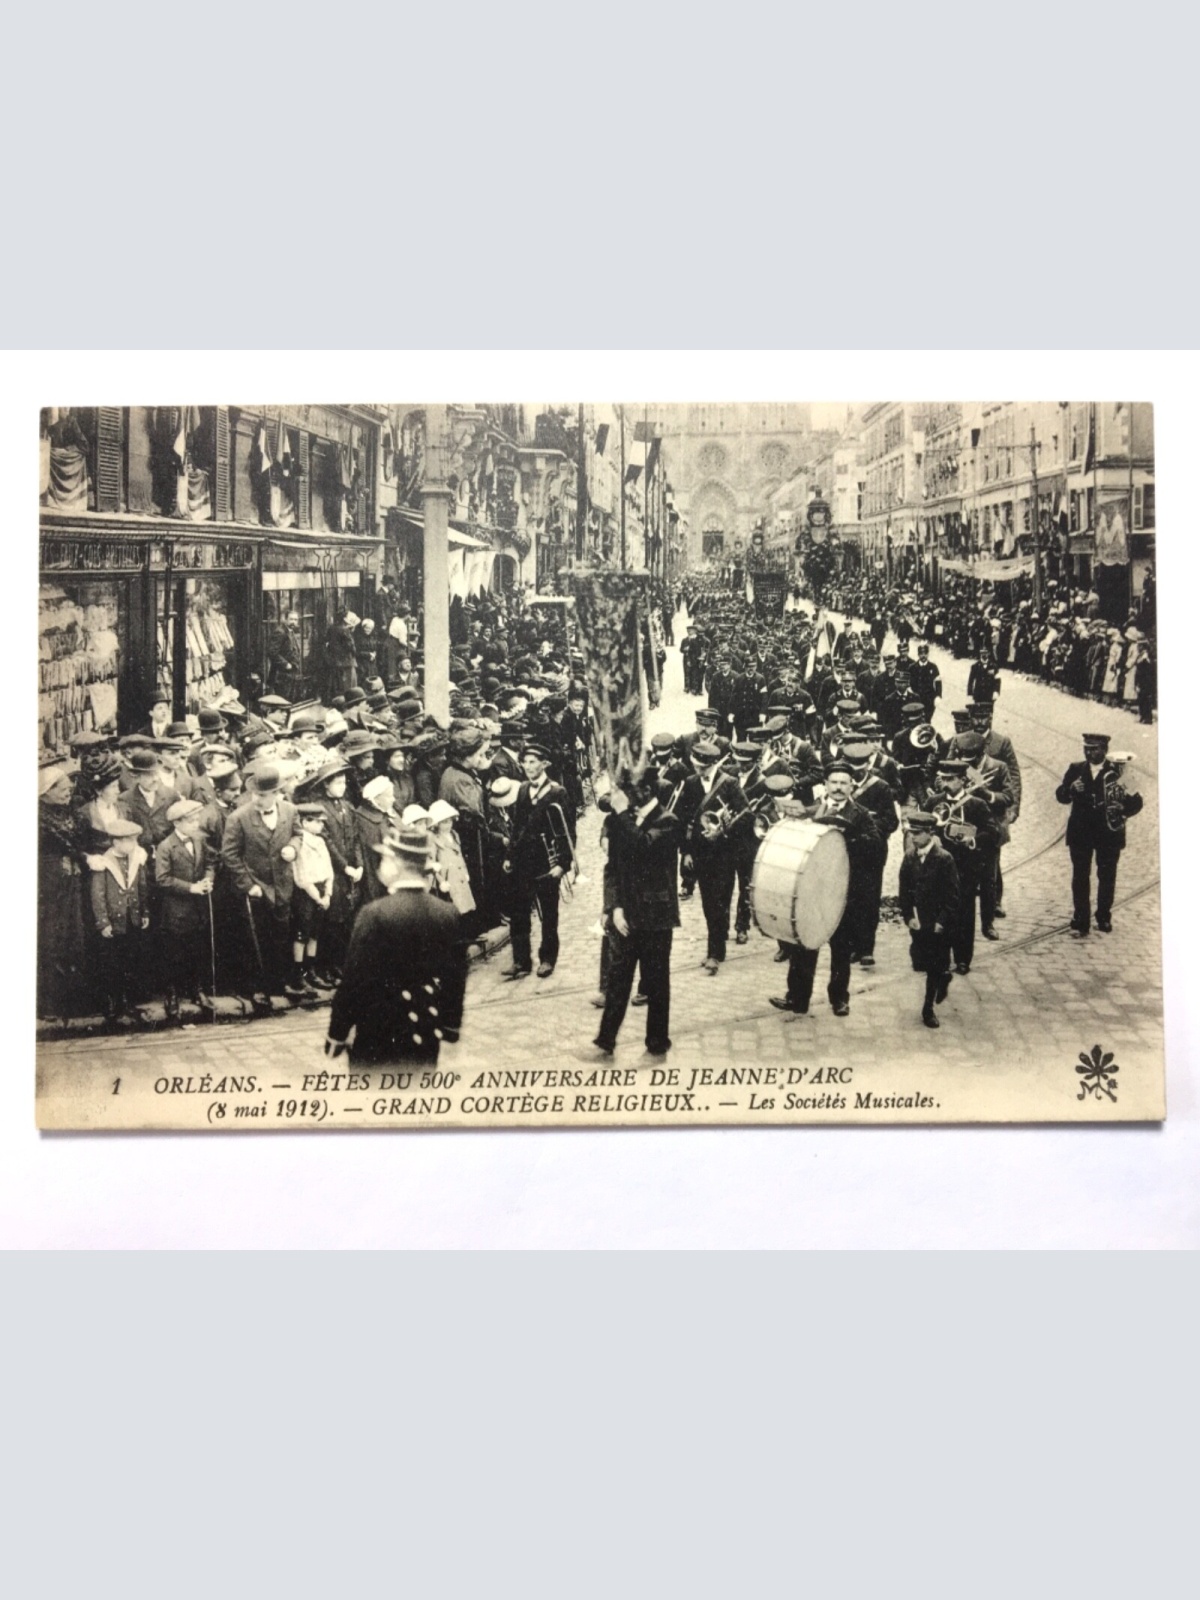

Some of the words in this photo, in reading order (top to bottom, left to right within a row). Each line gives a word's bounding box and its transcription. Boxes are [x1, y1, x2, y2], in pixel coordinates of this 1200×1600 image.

[111, 1078, 122, 1096] 1
[153, 1072, 264, 1094] ORLÉANS.
[301, 1070, 371, 1092] FÊTES
[379, 1072, 414, 1090] DU
[470, 1068, 638, 1089] ANNIVERSAIRE
[649, 1068, 680, 1087] DE
[234, 1101, 268, 1119] mai
[276, 1099, 335, 1122] 1912).
[371, 1097, 453, 1116] GRAND
[460, 1092, 564, 1114] CORTÈGE
[748, 1093, 776, 1111] Les
[783, 1092, 847, 1110] Sociétés
[853, 1091, 942, 1110] Musicales.
